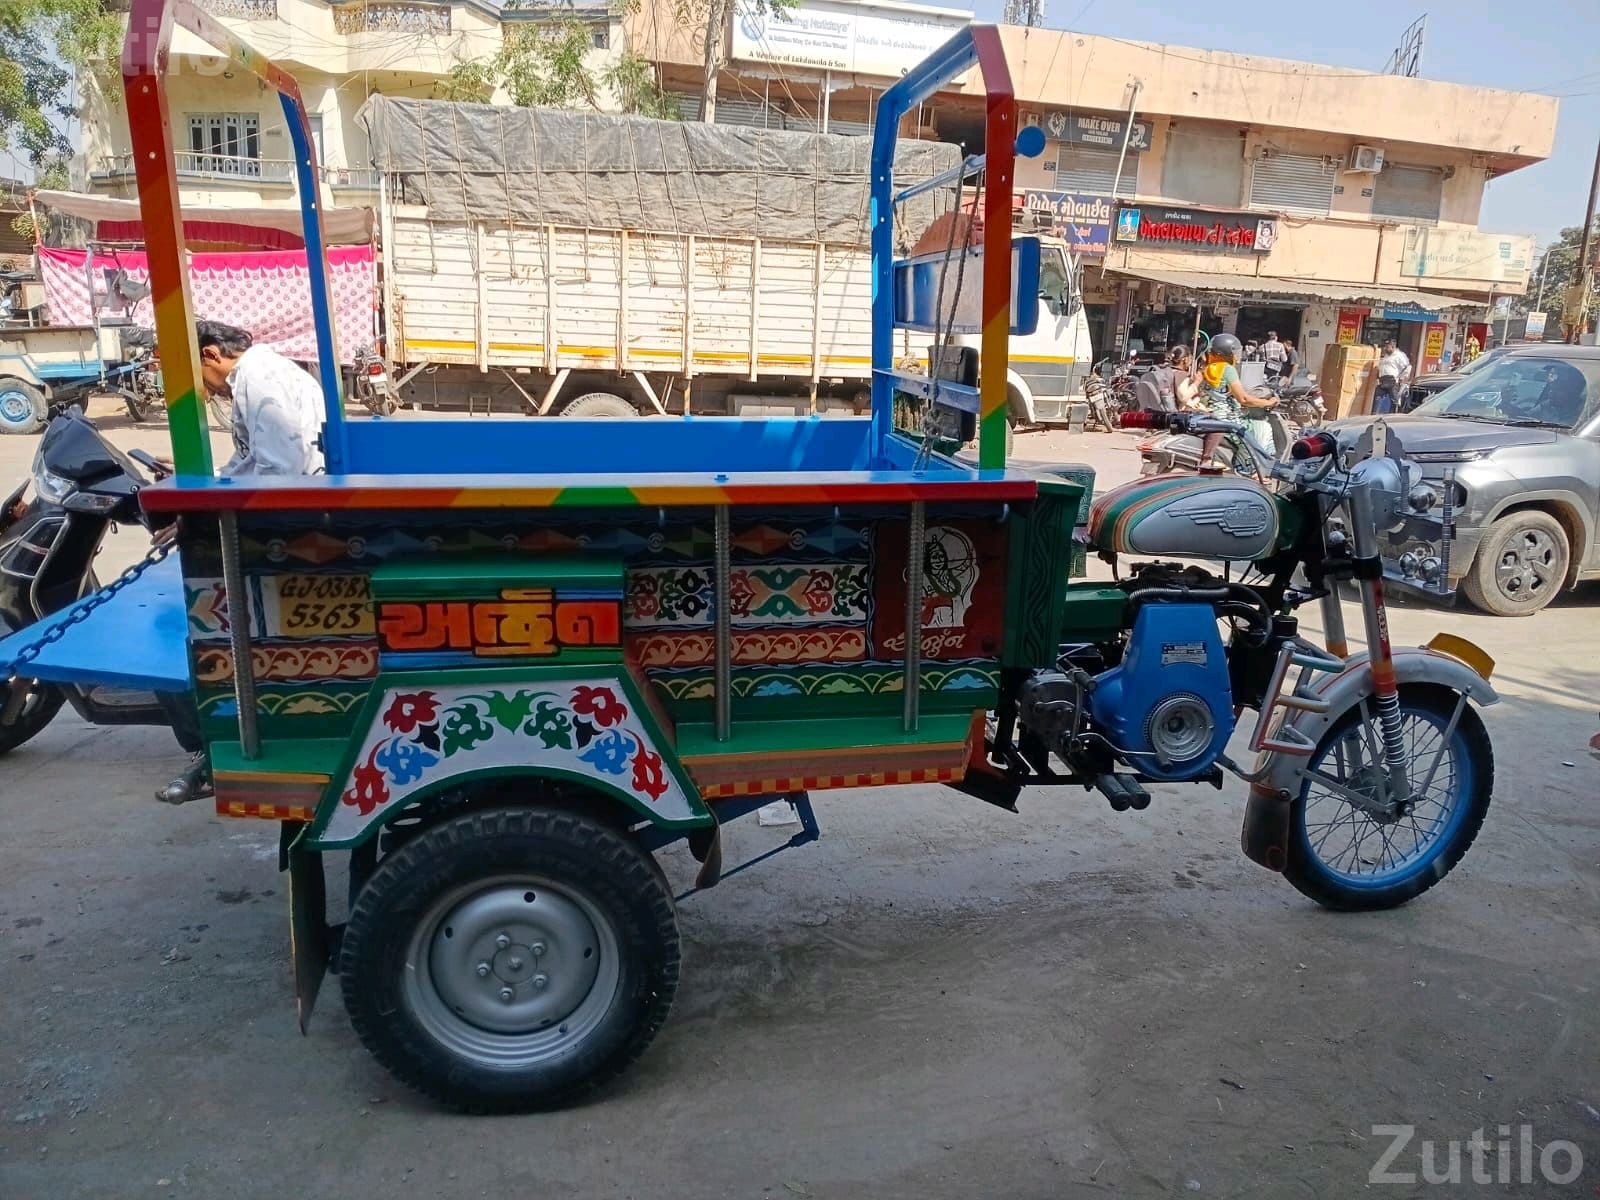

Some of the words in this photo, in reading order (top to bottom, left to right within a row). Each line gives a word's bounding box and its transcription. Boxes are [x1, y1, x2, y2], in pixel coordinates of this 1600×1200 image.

[748, 50, 754, 58] A
[783, 54, 790, 62] of
[1077, 117, 1100, 130] MAKE
[1100, 120, 1121, 133] OVER
[1060, 196, 1110, 219] મોબાઈલ
[286, 603, 364, 630] 5363
